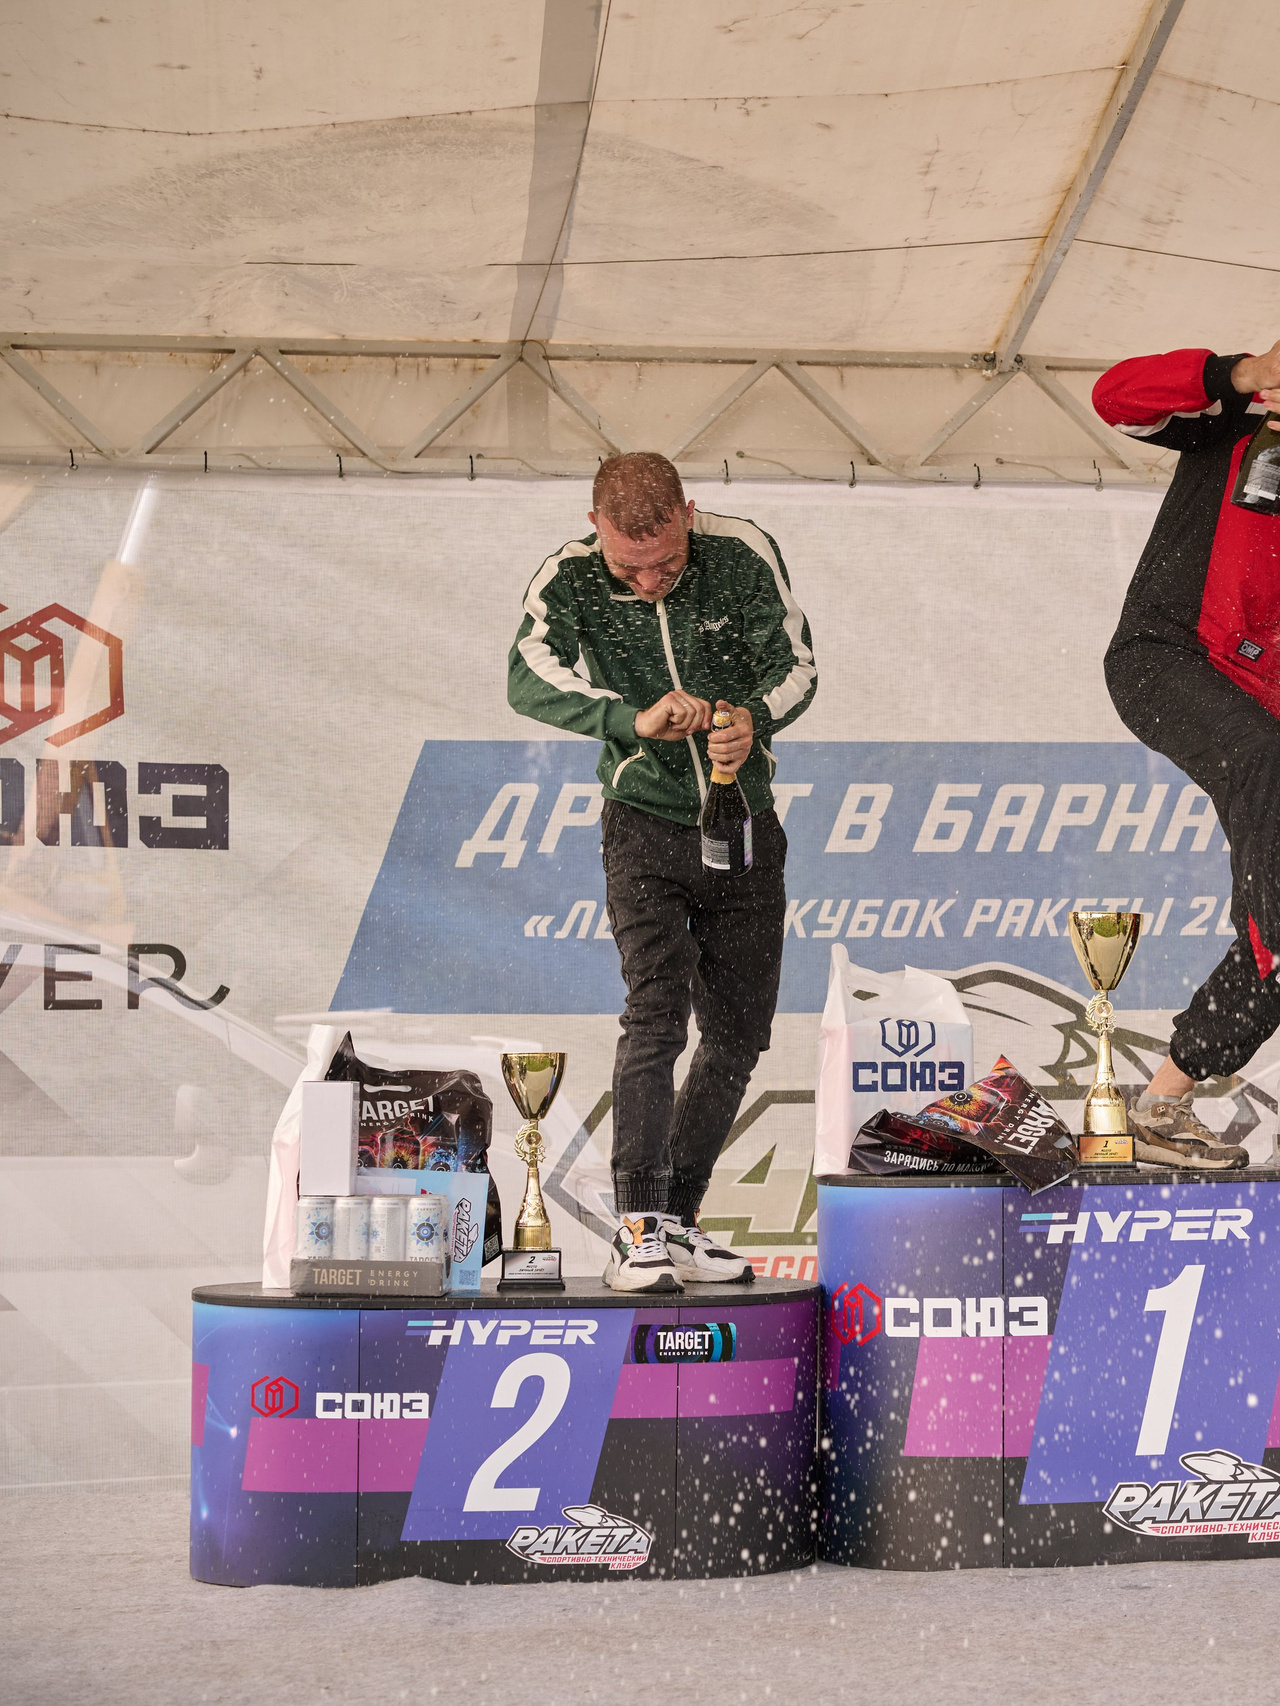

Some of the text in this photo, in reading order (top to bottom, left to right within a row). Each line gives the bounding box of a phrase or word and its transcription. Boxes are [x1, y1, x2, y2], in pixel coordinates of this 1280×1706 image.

[1240, 643, 1260, 657] OMP
[0, 758, 230, 850] ЮЗ
[824, 783, 894, 853] В
[784, 898, 960, 939] КУБОК
[852, 1061, 965, 1092] СОЮЗ
[361, 1096, 434, 1121] ARGET
[1003, 1099, 1060, 1155] ARGET
[1103, 1140, 1109, 1148] 1
[884, 1150, 939, 1172] ЗАРЯДИСЬ
[941, 1163, 956, 1172] ПО
[1046, 1208, 1254, 1245] HYPER
[528, 1256, 536, 1264] 2
[312, 1268, 363, 1286] TARGET
[370, 1269, 419, 1278] ENERGY
[370, 1279, 410, 1287] DRINK
[884, 1296, 1049, 1338] СОЮЗ
[427, 1320, 599, 1345] HYPER
[657, 1331, 712, 1350] TARGET
[1134, 1264, 1206, 1456] 1
[315, 1392, 430, 1420] СОЮЗ
[462, 1352, 571, 1512] 2
[508, 1527, 649, 1555] РАКЕТА
[1250, 1531, 1280, 1541] КЛУБ
[546, 1554, 647, 1563] СПОРТИВНО-ТЕХНИЧЕСКИЙ
